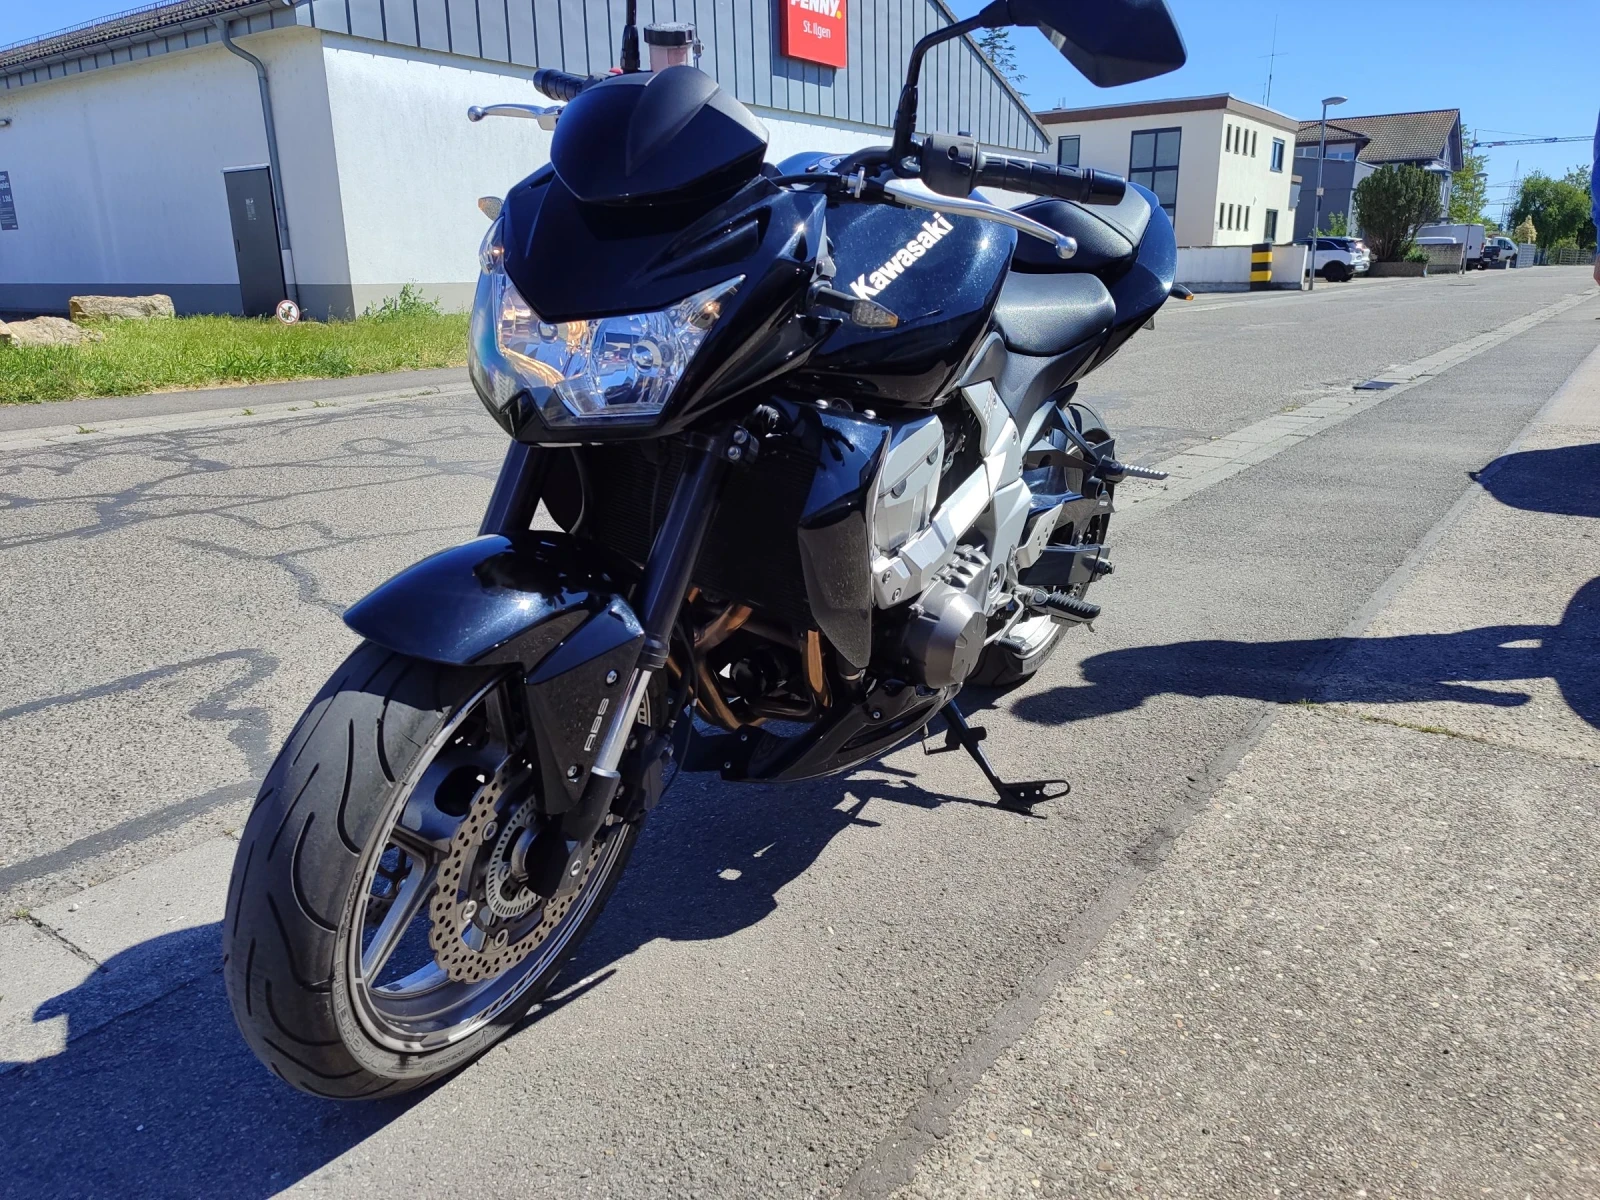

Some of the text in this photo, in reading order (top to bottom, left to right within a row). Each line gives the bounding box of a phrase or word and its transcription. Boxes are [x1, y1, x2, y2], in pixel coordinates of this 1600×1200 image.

[803, 20, 831, 39] St. Ilgen
[850, 212, 953, 300] Kawasaki
[584, 698, 609, 751] ABS
